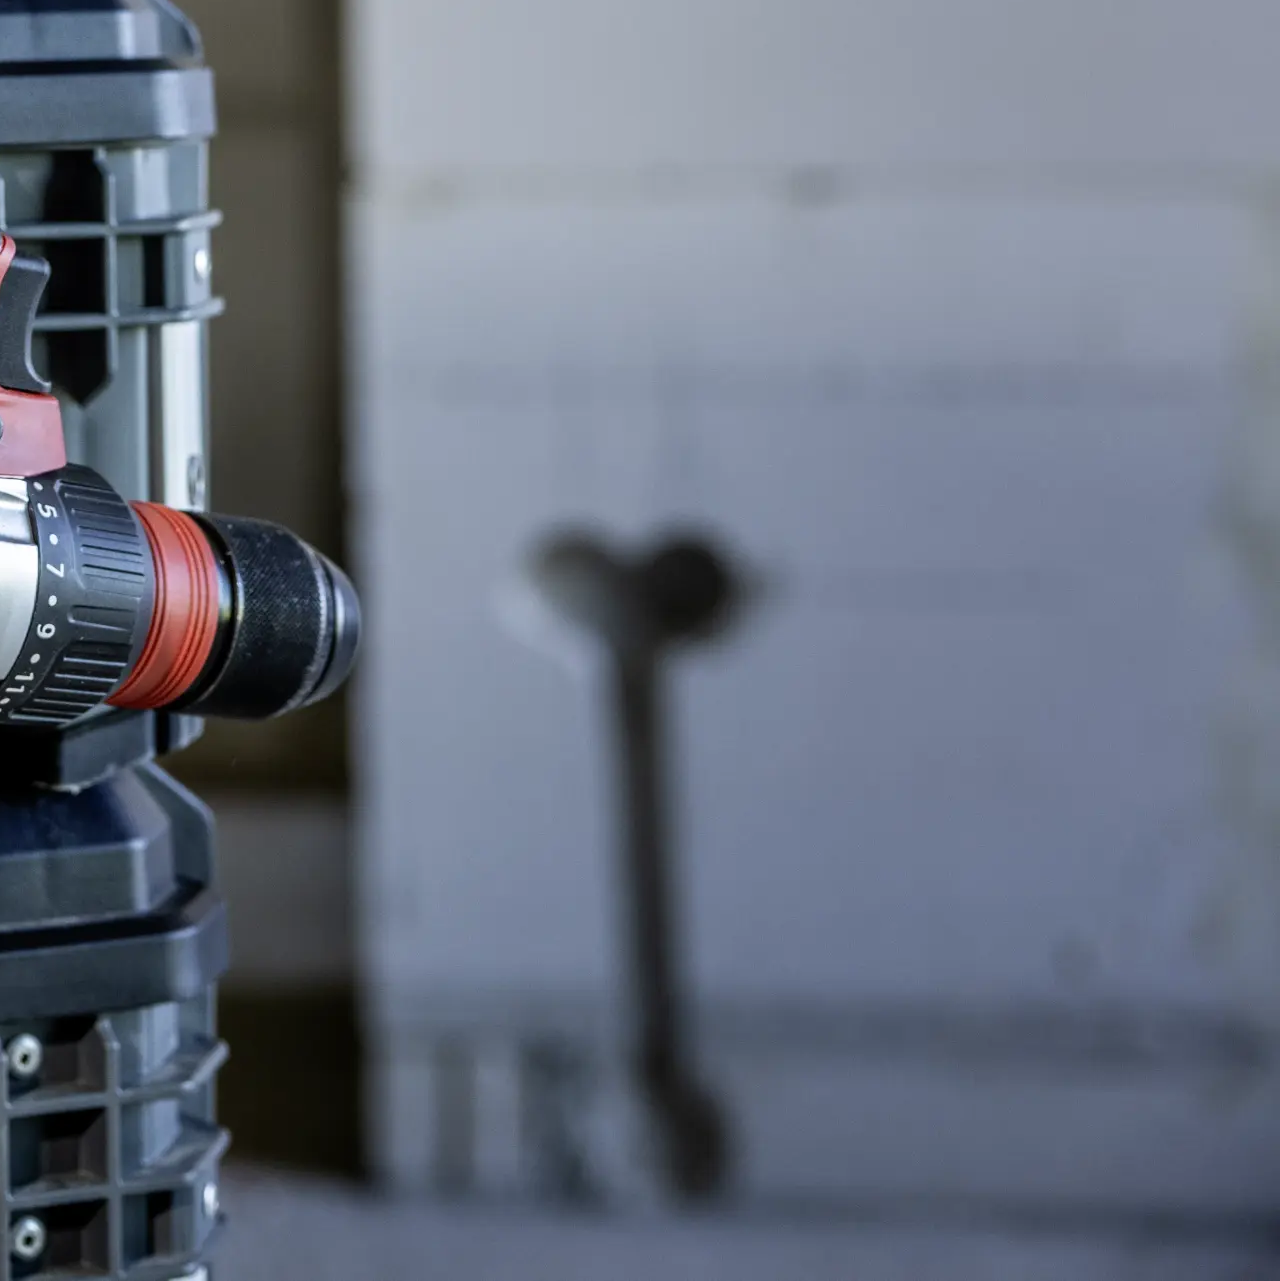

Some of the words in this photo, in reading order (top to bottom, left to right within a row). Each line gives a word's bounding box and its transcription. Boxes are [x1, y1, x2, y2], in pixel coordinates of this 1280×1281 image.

[37, 502, 58, 519] 5
[46, 563, 65, 579] 7
[37, 623, 56, 640] 9
[5, 672, 35, 693] 11
